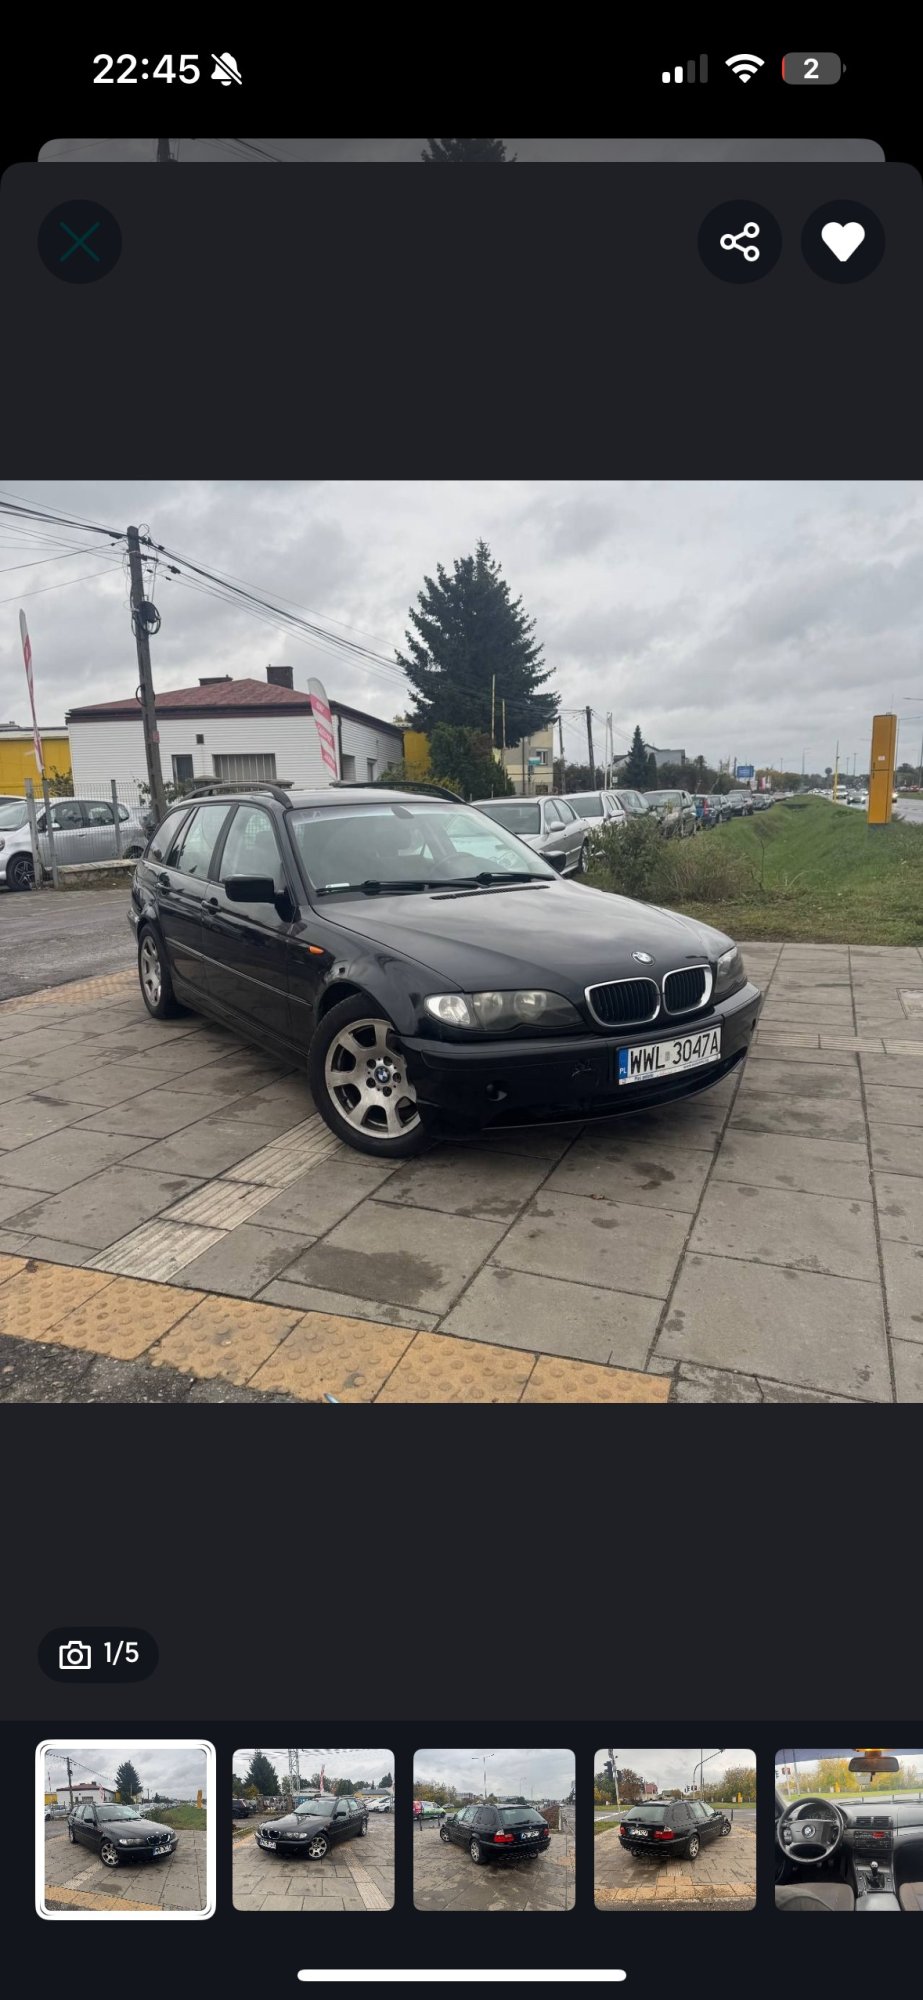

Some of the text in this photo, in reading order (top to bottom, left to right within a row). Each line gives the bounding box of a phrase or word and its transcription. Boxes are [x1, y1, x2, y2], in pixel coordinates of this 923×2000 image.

[630, 1031, 719, 1075] WWL 3047A
[619, 1067, 627, 1075] PL
